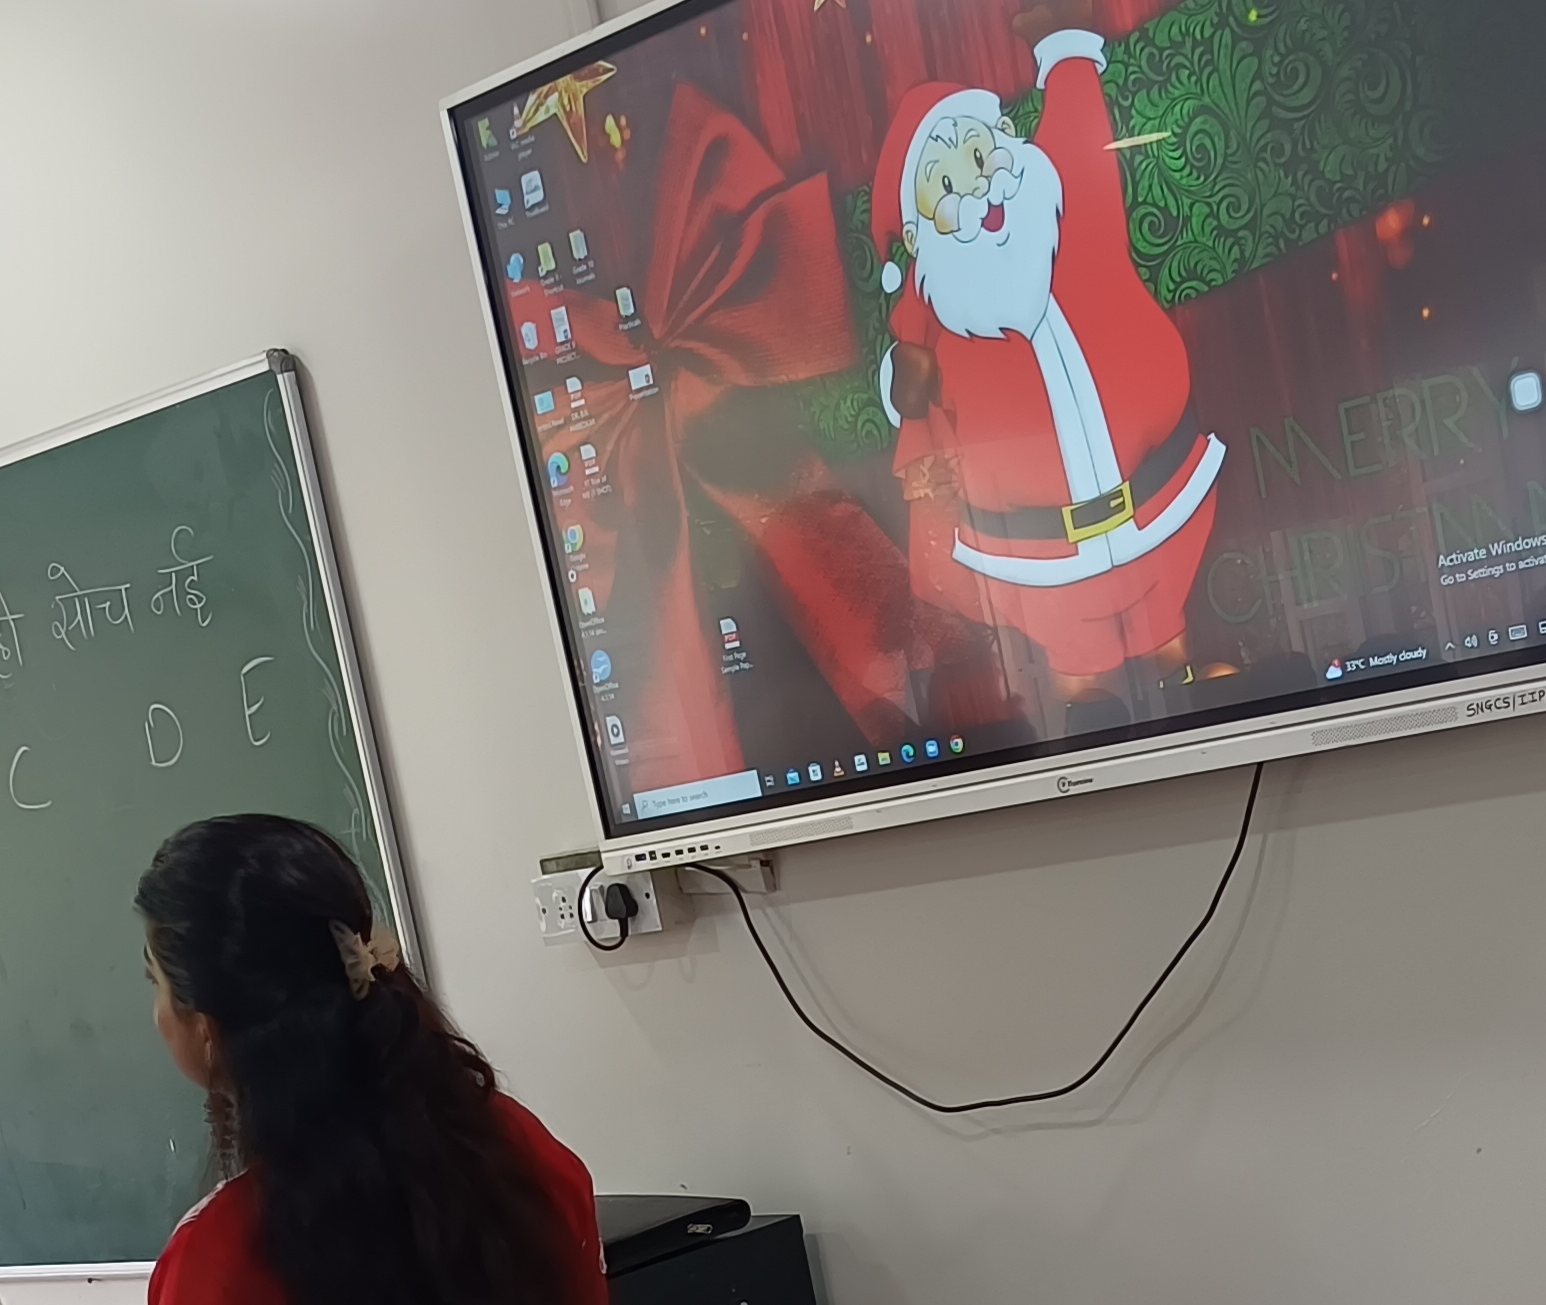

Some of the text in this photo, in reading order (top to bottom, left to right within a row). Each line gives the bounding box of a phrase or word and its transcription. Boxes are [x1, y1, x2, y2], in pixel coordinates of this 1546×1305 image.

[1250, 356, 1519, 499] MERRY
[47, 563, 135, 651] सोच
[151, 525, 214, 627] नई
[1438, 546, 1487, 568] Activate
[1440, 573, 1455, 586] Go
[1456, 571, 1467, 582] to
[1467, 562, 1504, 581] Settings
[1505, 559, 1516, 571] to
[1369, 652, 1397, 668] Mostly
[1399, 647, 1427, 662] cloudy
[9, 745, 52, 810] C
[145, 703, 183, 767] D
[240, 656, 275, 746] E
